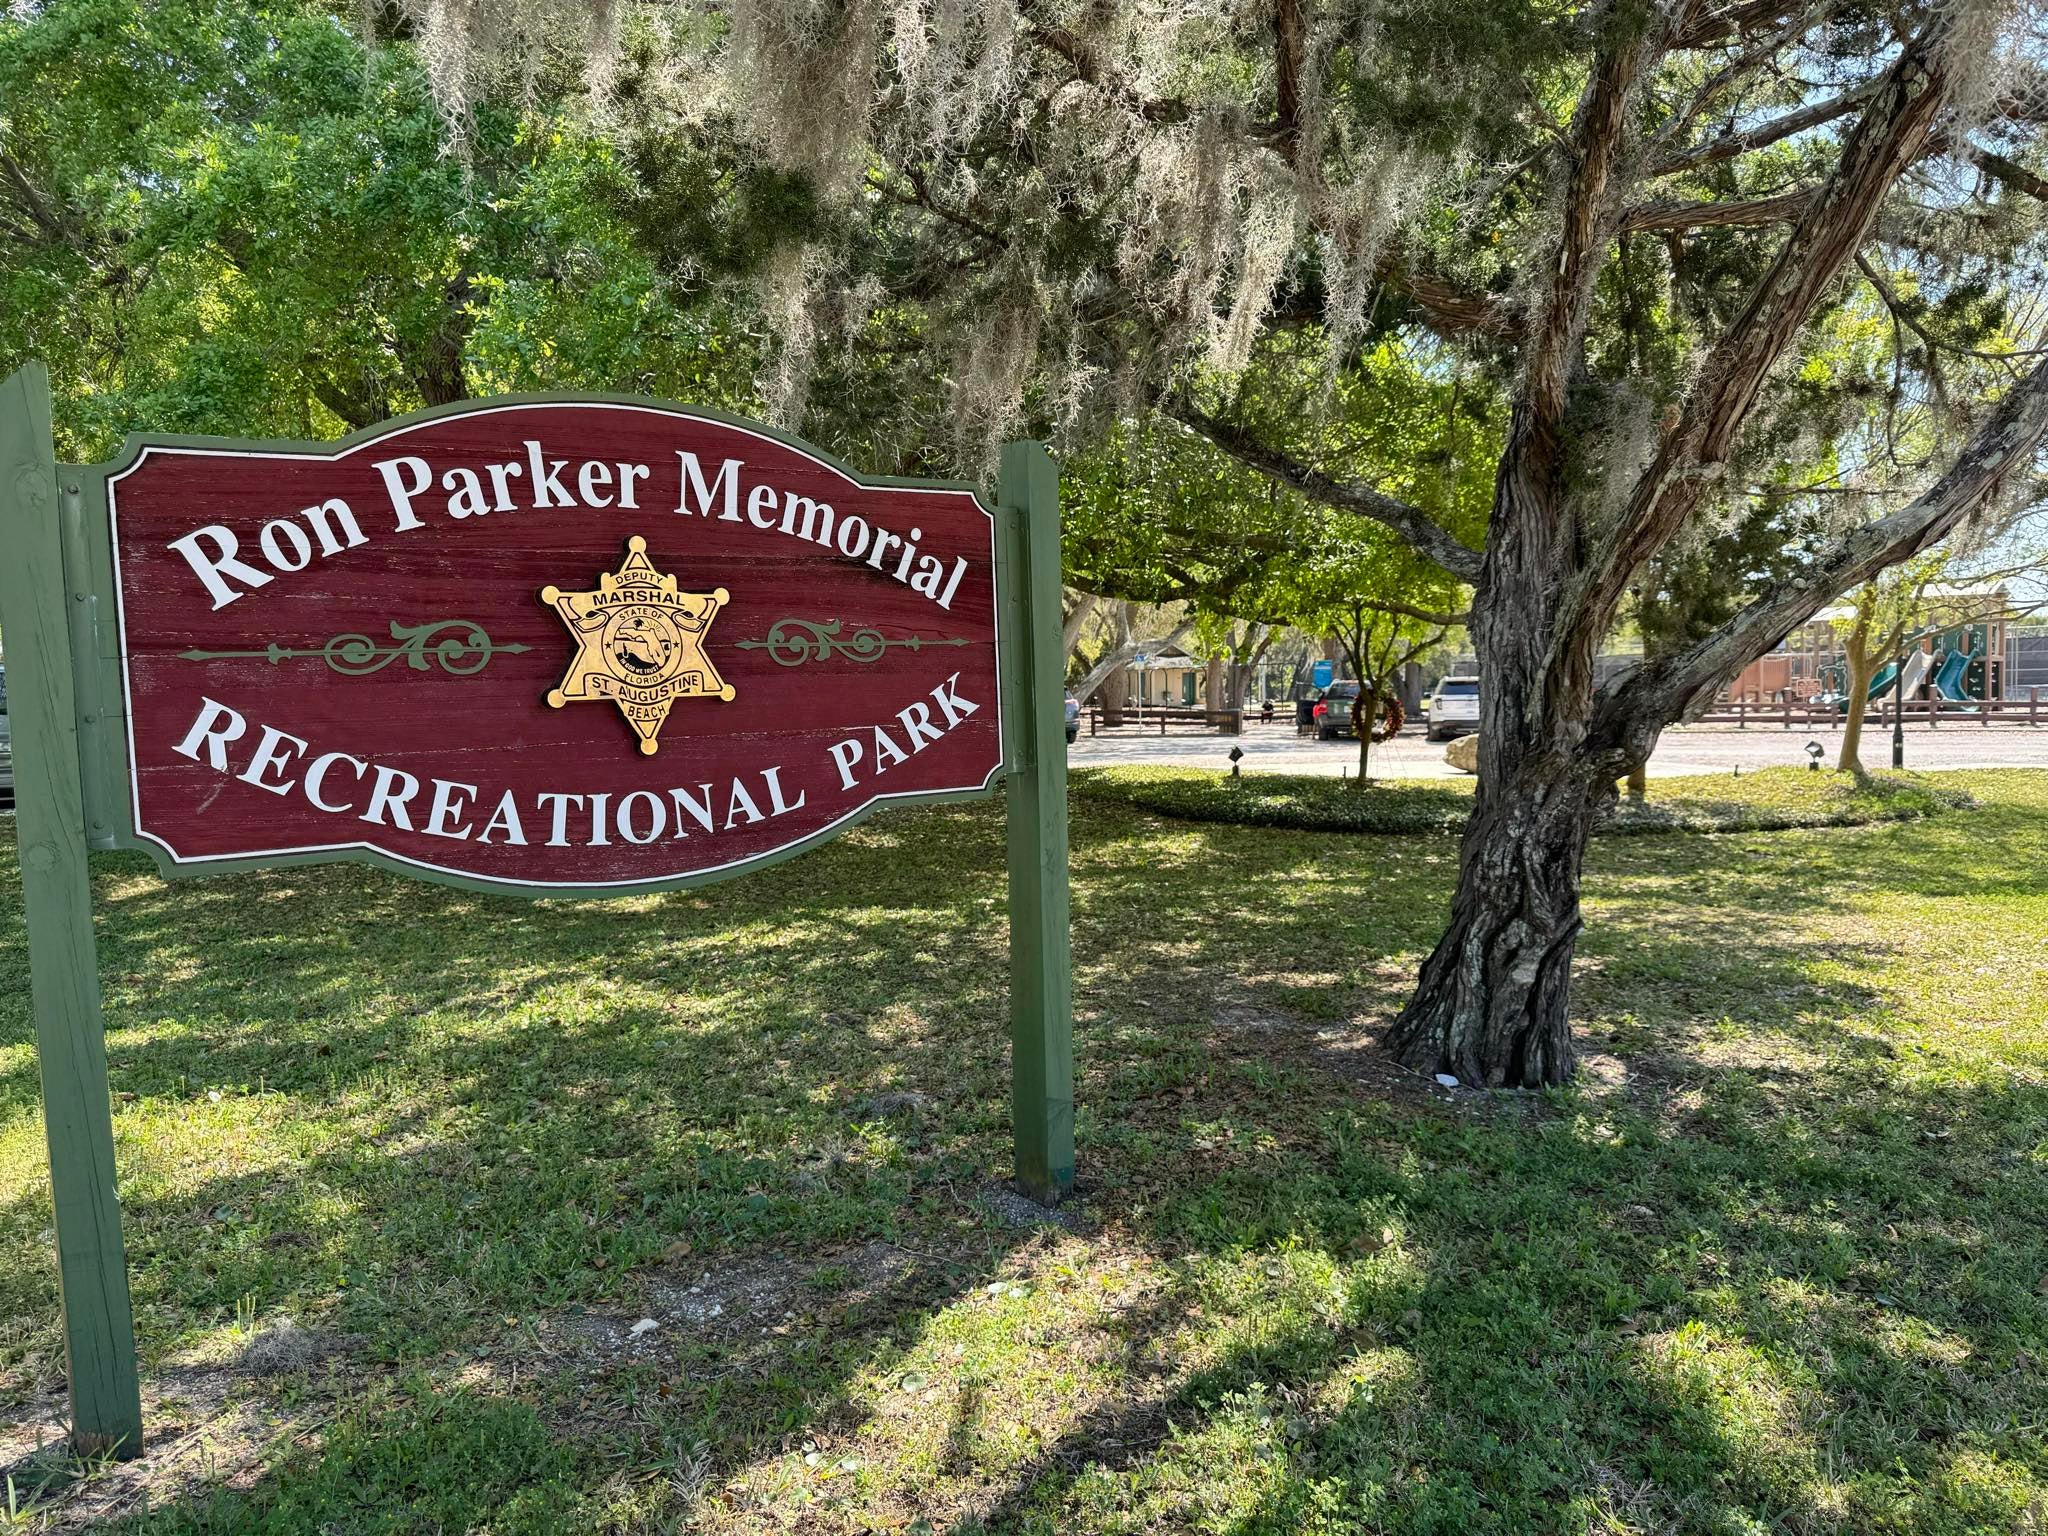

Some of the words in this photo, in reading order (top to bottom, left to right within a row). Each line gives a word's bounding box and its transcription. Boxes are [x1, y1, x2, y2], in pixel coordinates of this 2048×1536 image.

[167, 499, 369, 610] Ron
[372, 441, 650, 533] Parker
[674, 451, 968, 610] Memorial
[615, 572, 664, 585] DEPUTY
[592, 590, 686, 607] MARSHAL
[619, 607, 648, 621] STATE
[651, 610, 664, 620] OF
[624, 672, 666, 685] FLORIDA
[592, 676, 614, 693] ST.
[618, 675, 698, 702] AUGUSTINE
[628, 704, 666, 719] BEACH
[172, 697, 805, 847] RECREATIONAL
[828, 672, 980, 791] PARK
